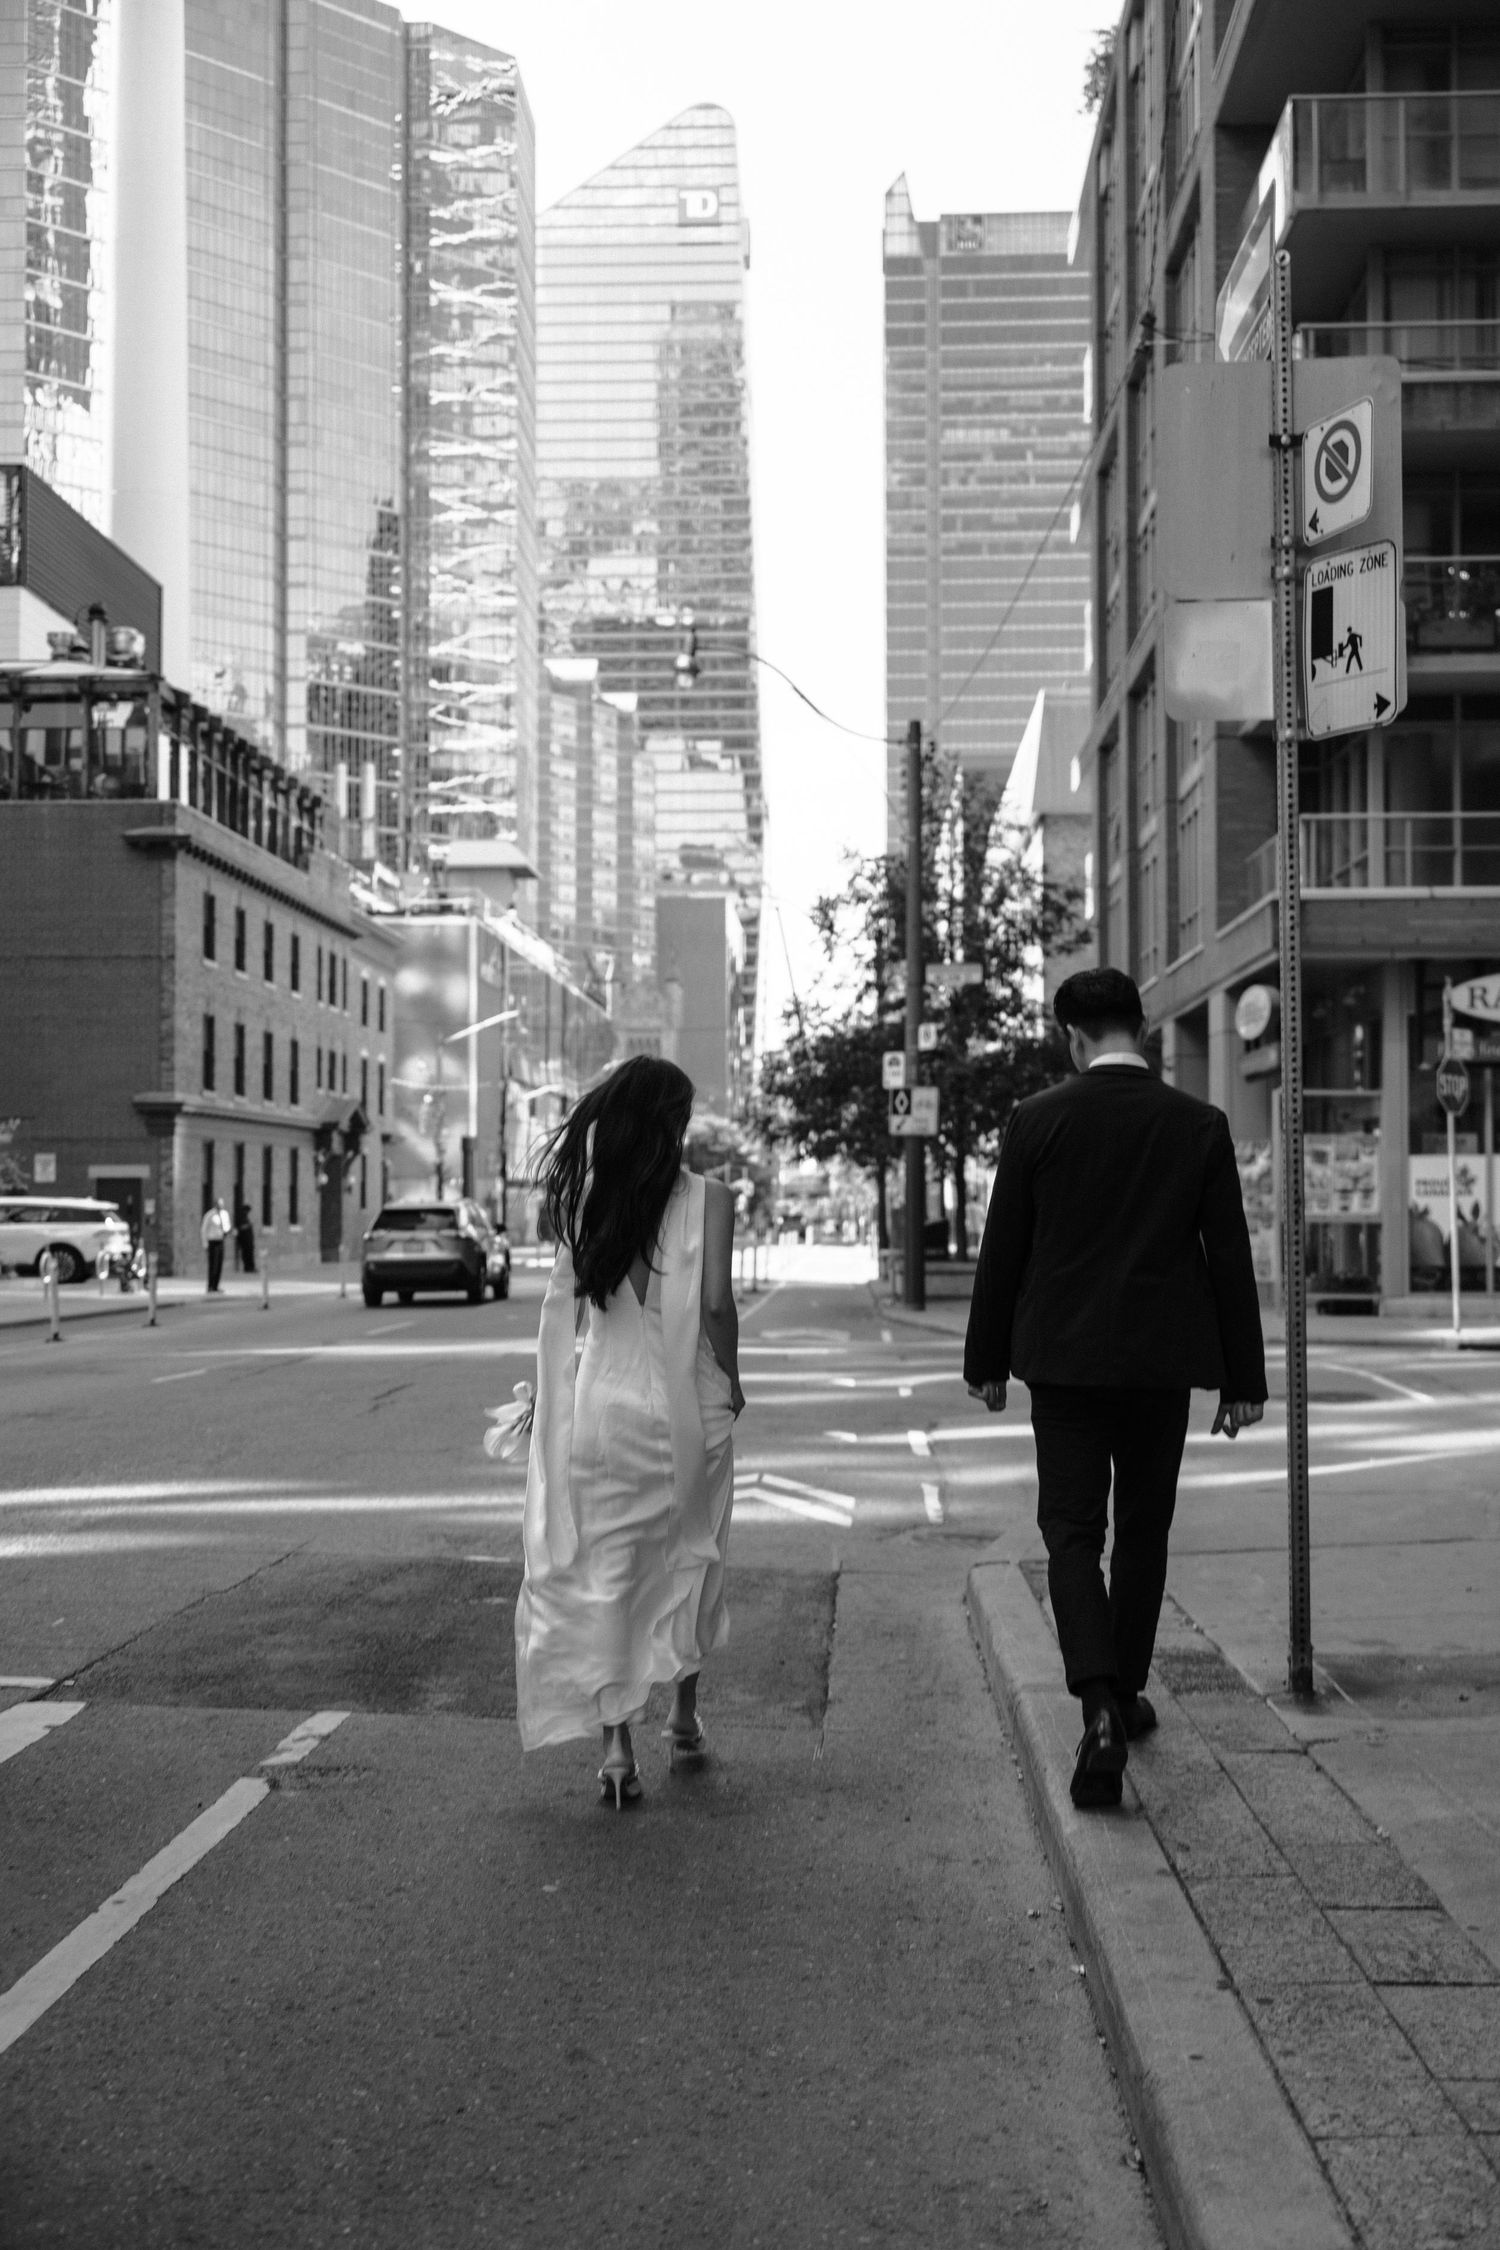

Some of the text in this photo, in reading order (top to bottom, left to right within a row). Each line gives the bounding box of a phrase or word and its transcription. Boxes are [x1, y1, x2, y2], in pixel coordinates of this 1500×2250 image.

[679, 190, 717, 218] TD
[1311, 551, 1389, 588] LOADING ZONE
[1440, 1073, 1467, 1098] STOP
